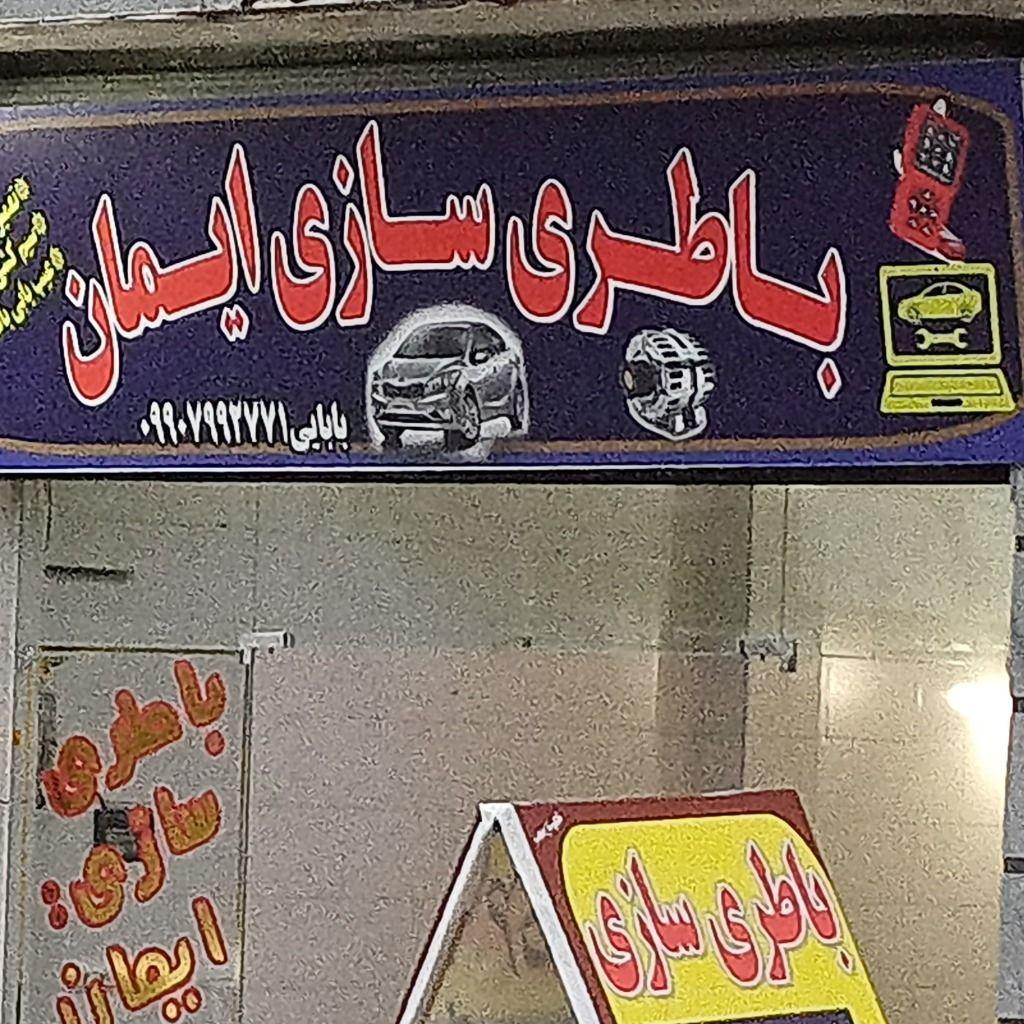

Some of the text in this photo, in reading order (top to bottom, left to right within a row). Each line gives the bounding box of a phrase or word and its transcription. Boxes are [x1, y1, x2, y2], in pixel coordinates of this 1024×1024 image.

[62, 120, 845, 406] باطری سازی ایمان
[41, 658, 227, 818] باطری
[581, 840, 857, 998] باطری سازی
